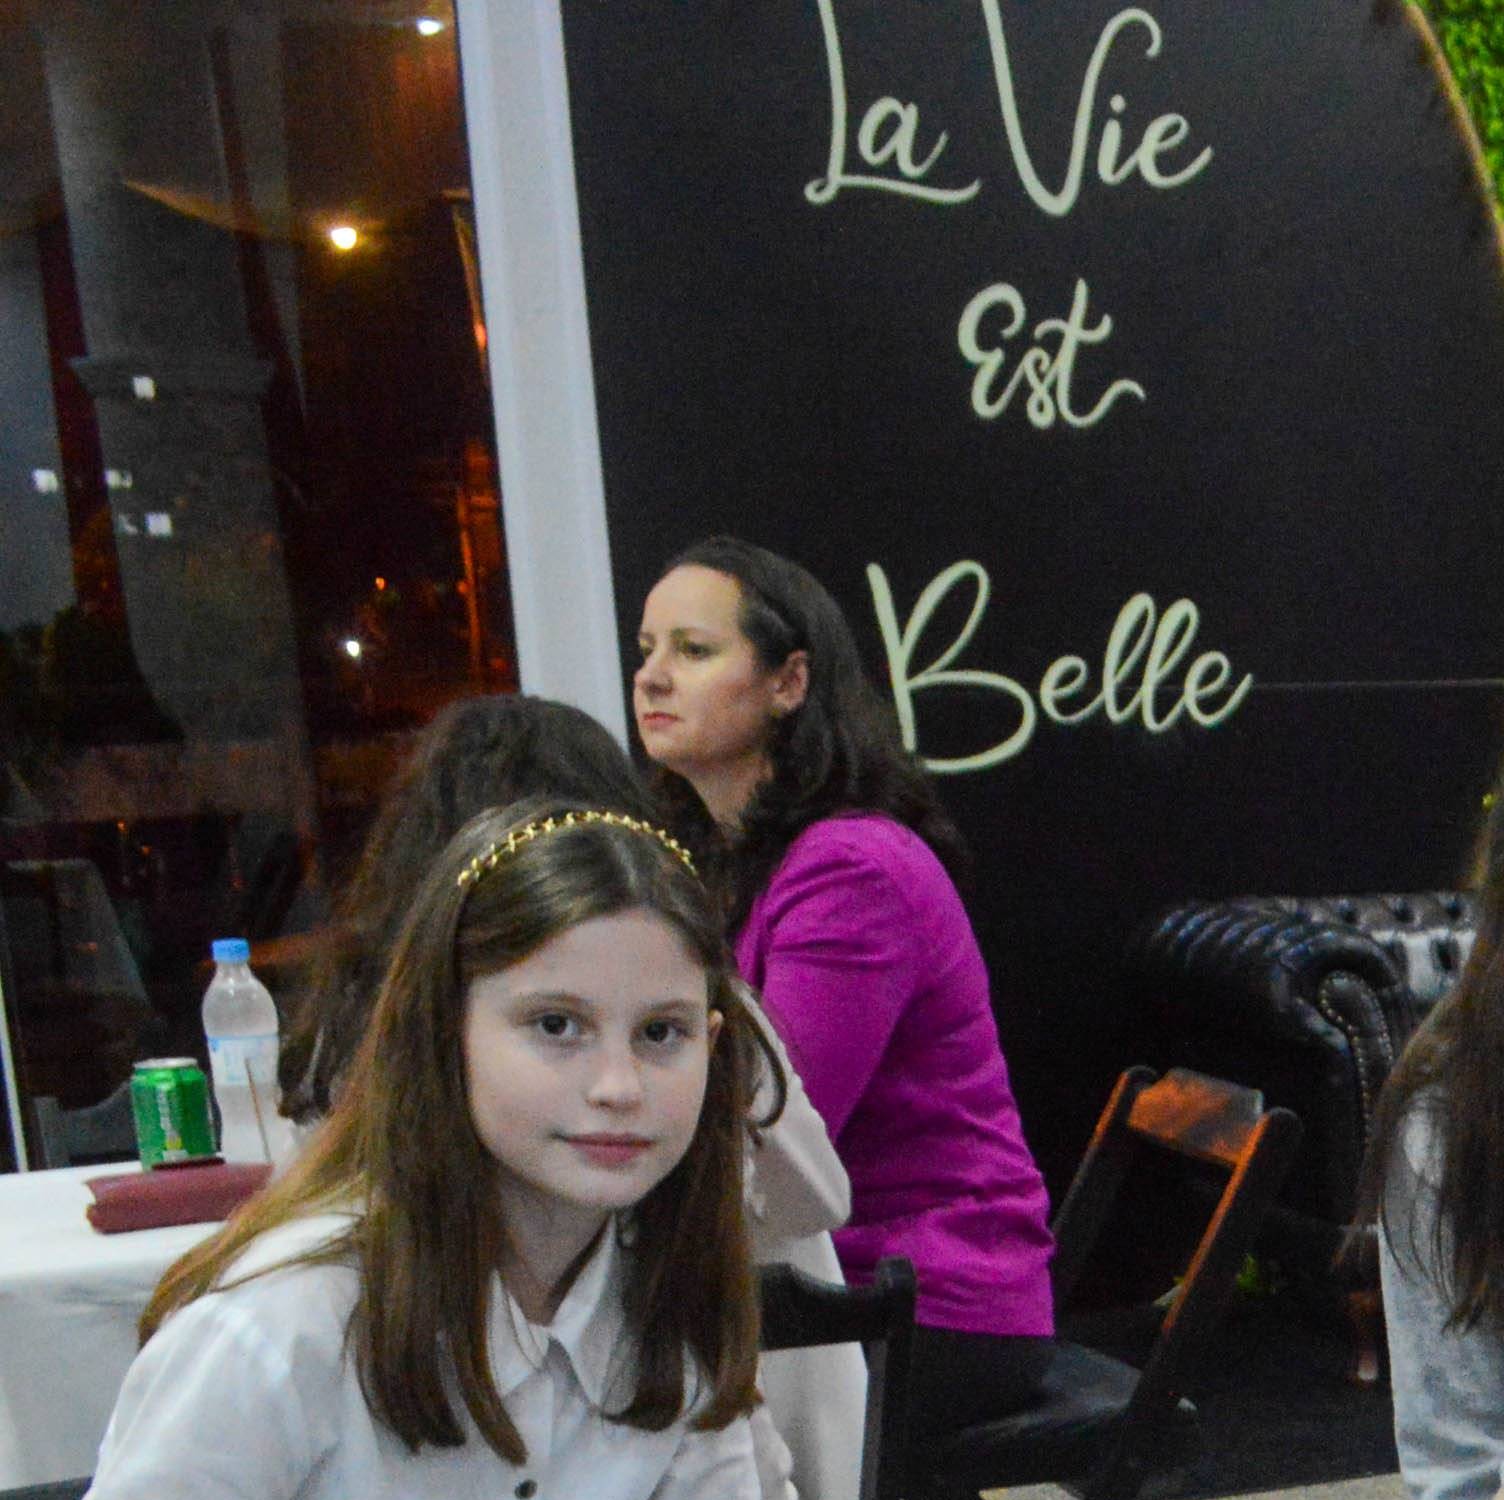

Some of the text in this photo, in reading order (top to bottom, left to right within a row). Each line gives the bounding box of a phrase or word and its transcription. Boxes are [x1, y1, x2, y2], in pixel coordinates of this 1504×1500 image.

[804, 0, 1213, 217] La Vie
[957, 278, 1146, 430] Est
[865, 559, 1253, 774] Belle
